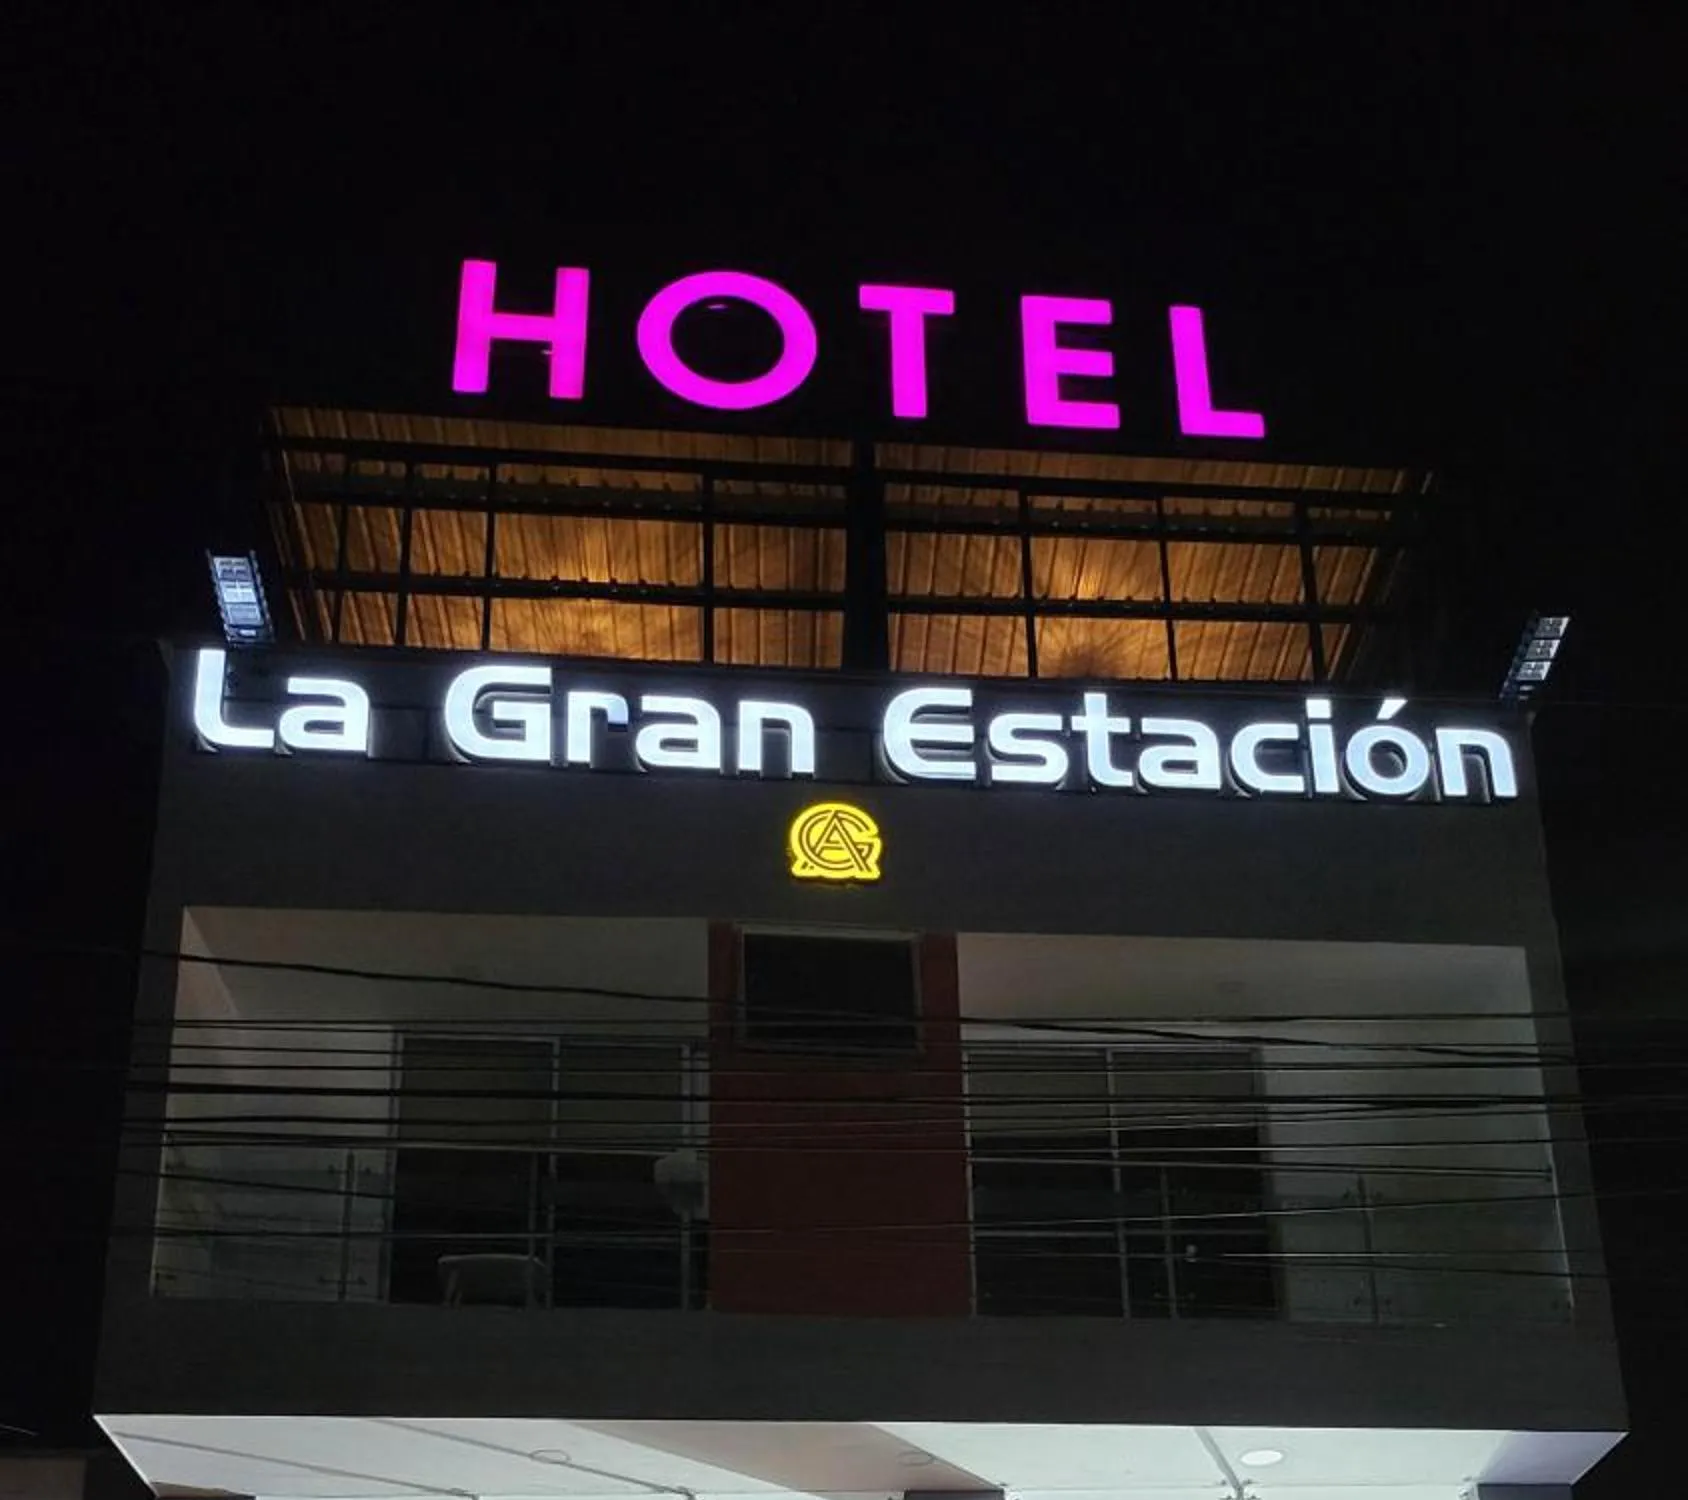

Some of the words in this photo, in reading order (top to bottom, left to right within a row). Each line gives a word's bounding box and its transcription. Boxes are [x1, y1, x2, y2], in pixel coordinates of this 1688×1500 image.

[452, 259, 1265, 438] HOTEL
[193, 648, 370, 752] La
[444, 665, 816, 774] Gran
[882, 686, 1517, 797] Estación
